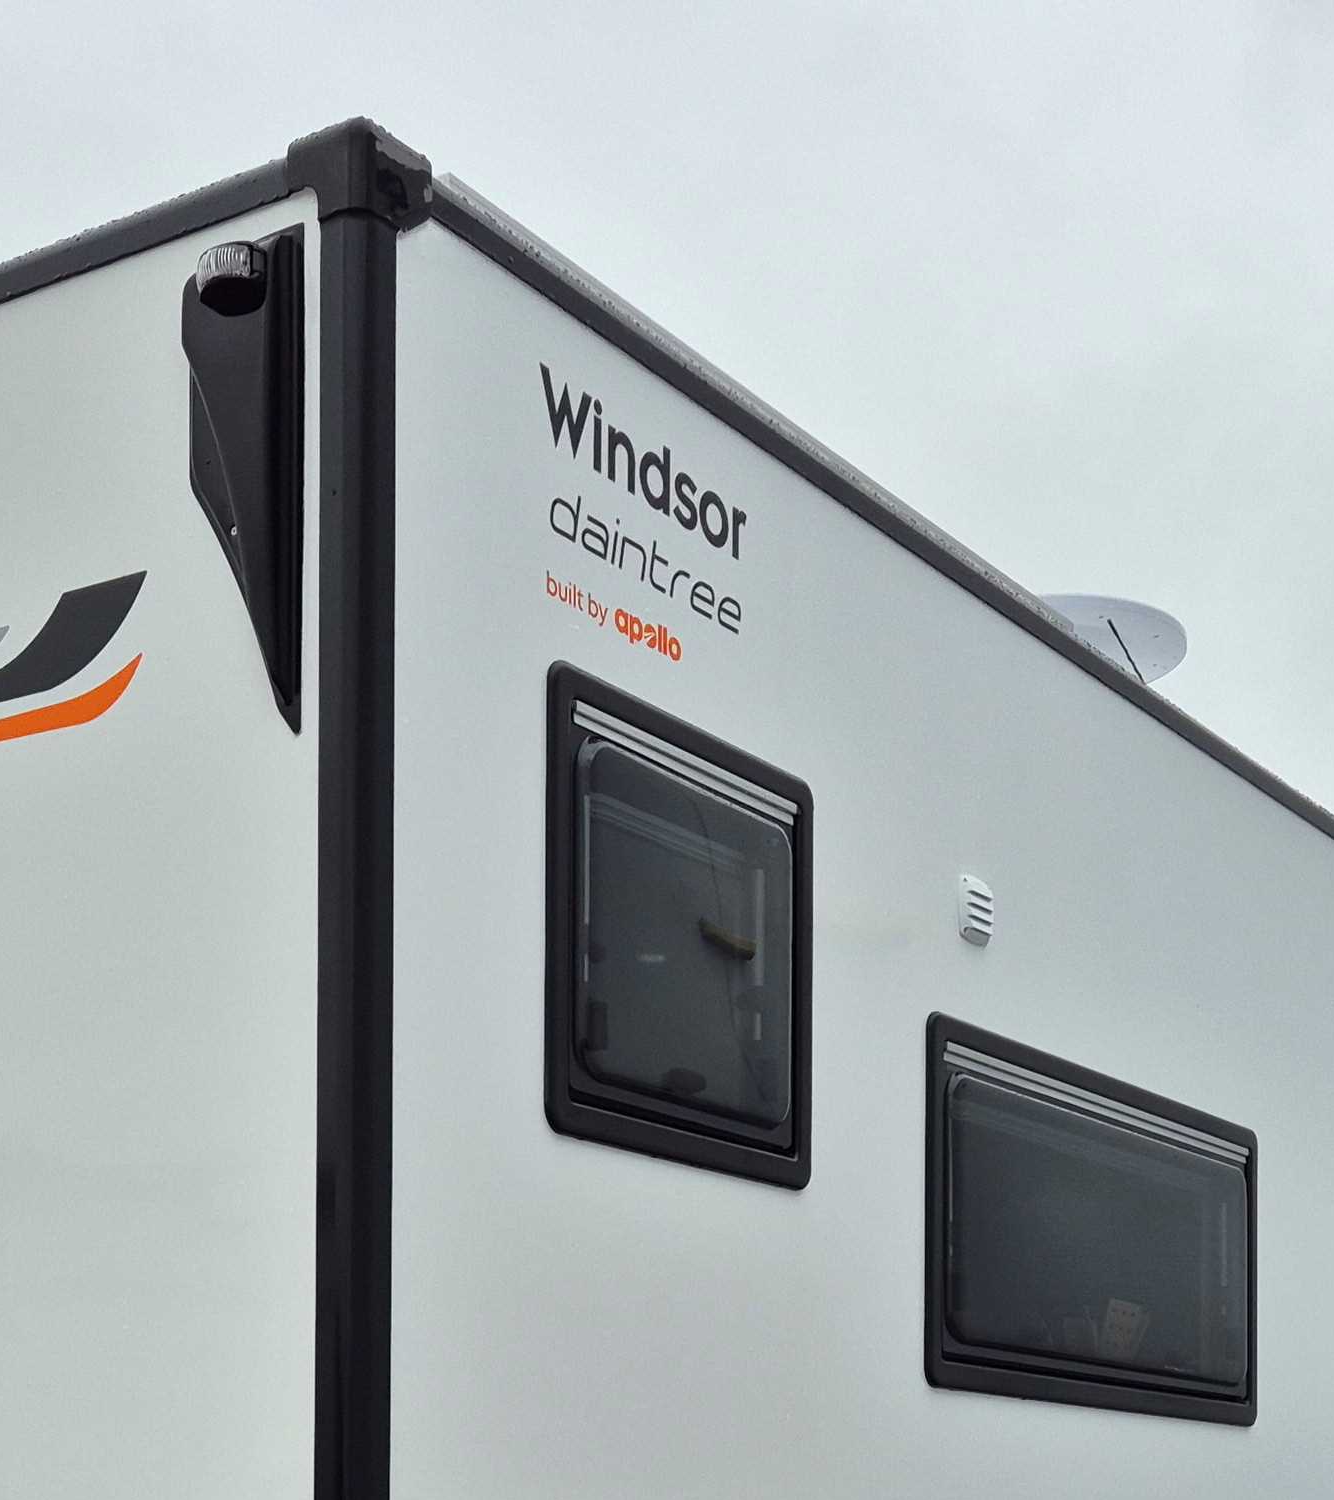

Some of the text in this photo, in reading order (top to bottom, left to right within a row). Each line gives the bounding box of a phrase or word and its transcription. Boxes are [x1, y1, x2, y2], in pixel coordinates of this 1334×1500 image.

[539, 361, 747, 560] Windsor
[546, 569, 682, 661] built by apollo
[549, 495, 741, 634] daintree
